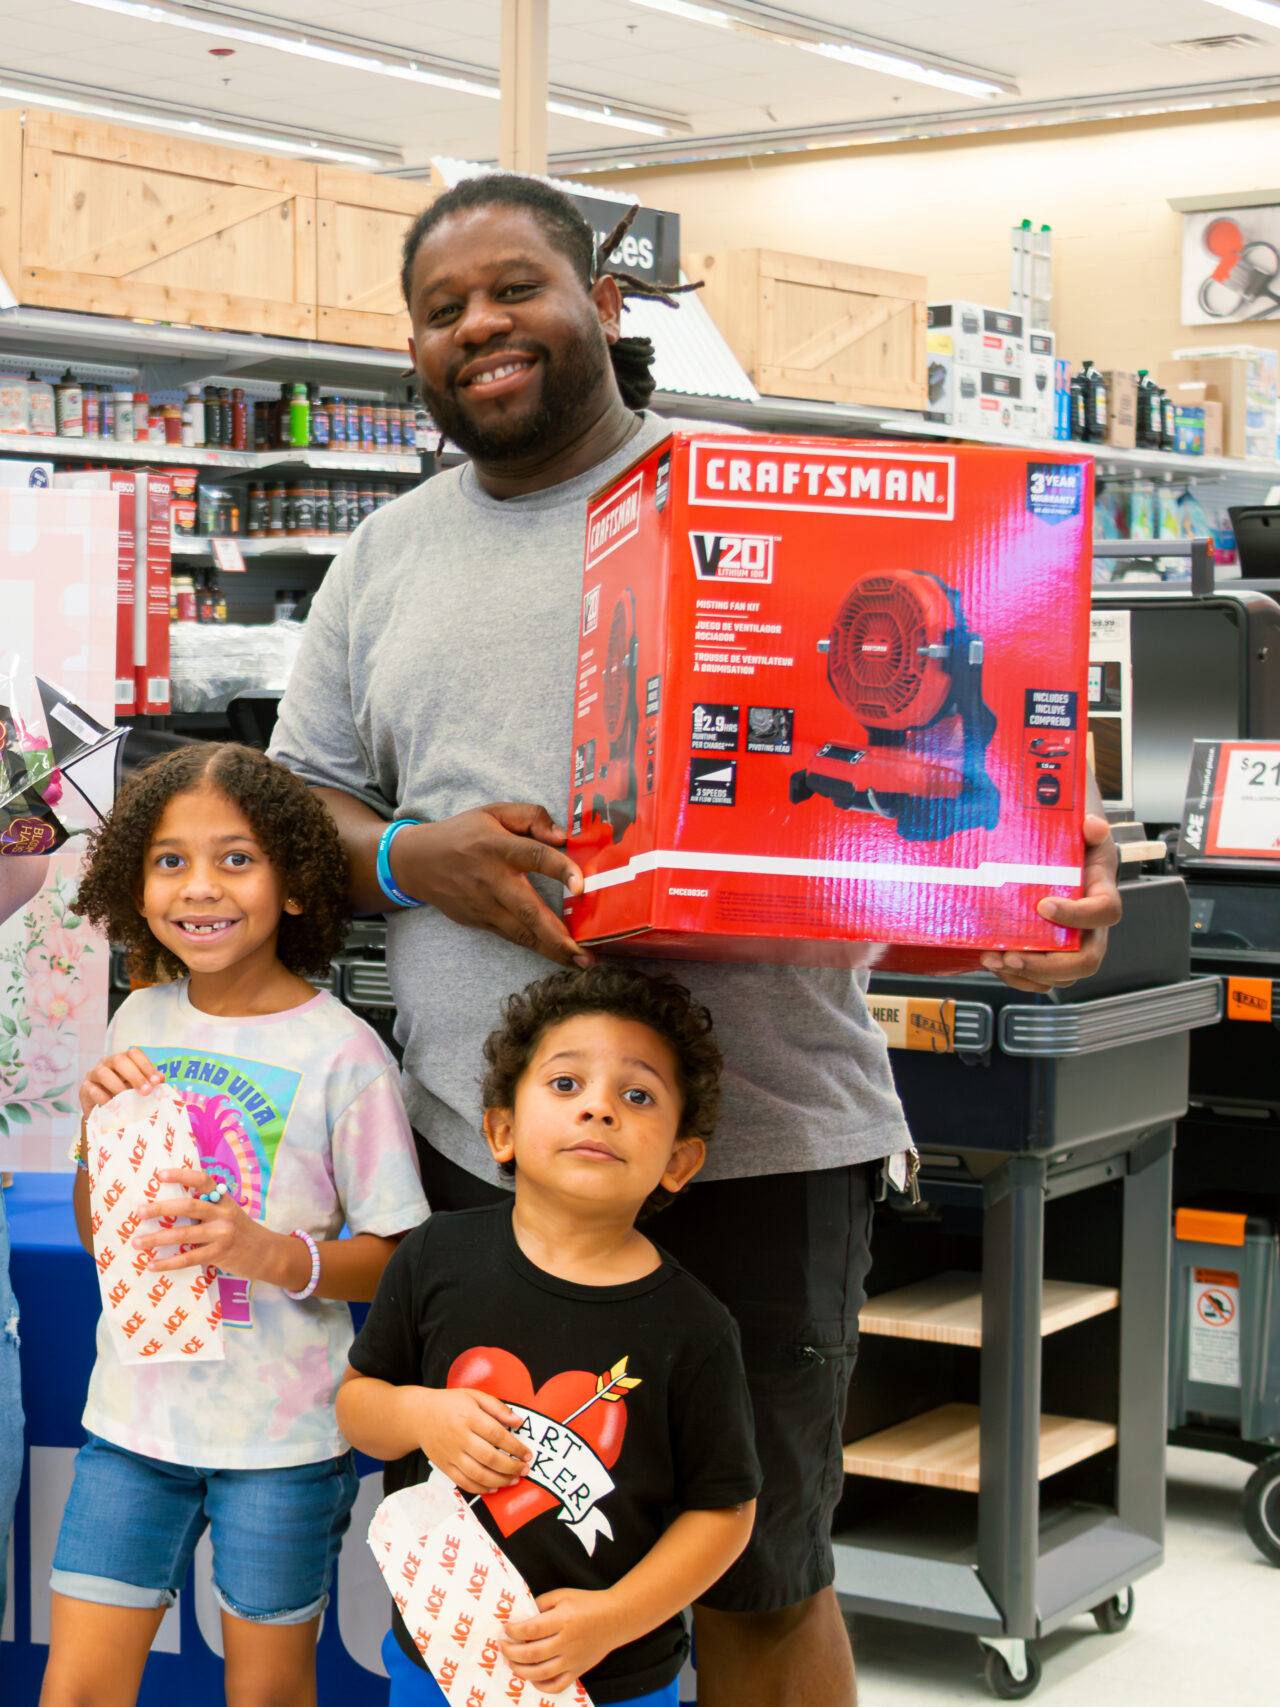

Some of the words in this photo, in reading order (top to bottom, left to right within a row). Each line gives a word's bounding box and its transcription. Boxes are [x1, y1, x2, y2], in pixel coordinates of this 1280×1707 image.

[112, 482, 135, 492] NESCO
[149, 482, 170, 493] NESCO
[706, 458, 936, 503] CRAFTSMAN
[1031, 473, 1045, 494] 3
[1045, 475, 1076, 488] YEAR
[590, 491, 638, 553] CRAFTSMAN
[693, 535, 765, 577] V20
[696, 600, 728, 610] MISTING
[730, 602, 745, 610] FAN
[747, 603, 760, 612] KIT
[695, 621, 721, 630] JUEGO
[722, 622, 732, 631] DE
[734, 623, 781, 634] VENTILADOR
[695, 632, 735, 642] ROCIADOR
[701, 663, 755, 675] BRUMISATION
[730, 654, 740, 663] DE
[742, 655, 793, 666] VENTILATEUR
[1033, 692, 1069, 703] INCLUDES
[1035, 704, 1066, 715] INCLUYE
[1029, 715, 1071, 727] COMPREND
[873, 1007, 900, 1023] HERE
[184, 1060, 229, 1086] AND
[227, 1075, 277, 1127] VIVA
[128, 1134, 148, 1173] ACE
[103, 1179, 126, 1213] ACE
[116, 1211, 142, 1244] ACE
[96, 1246, 116, 1275] ACE
[108, 1279, 131, 1309] ACE
[147, 1274, 173, 1308] ACE
[121, 1311, 147, 1339] ACE
[163, 1306, 189, 1336] ACE
[401, 1552, 422, 1588] ACE
[439, 1534, 461, 1576] ACE
[466, 1562, 489, 1601] ACE
[424, 1584, 447, 1620] ACE
[493, 1588, 516, 1624] ACE
[451, 1612, 474, 1648] ACE
[478, 1638, 500, 1677] ACE
[437, 1657, 459, 1694] ACE
